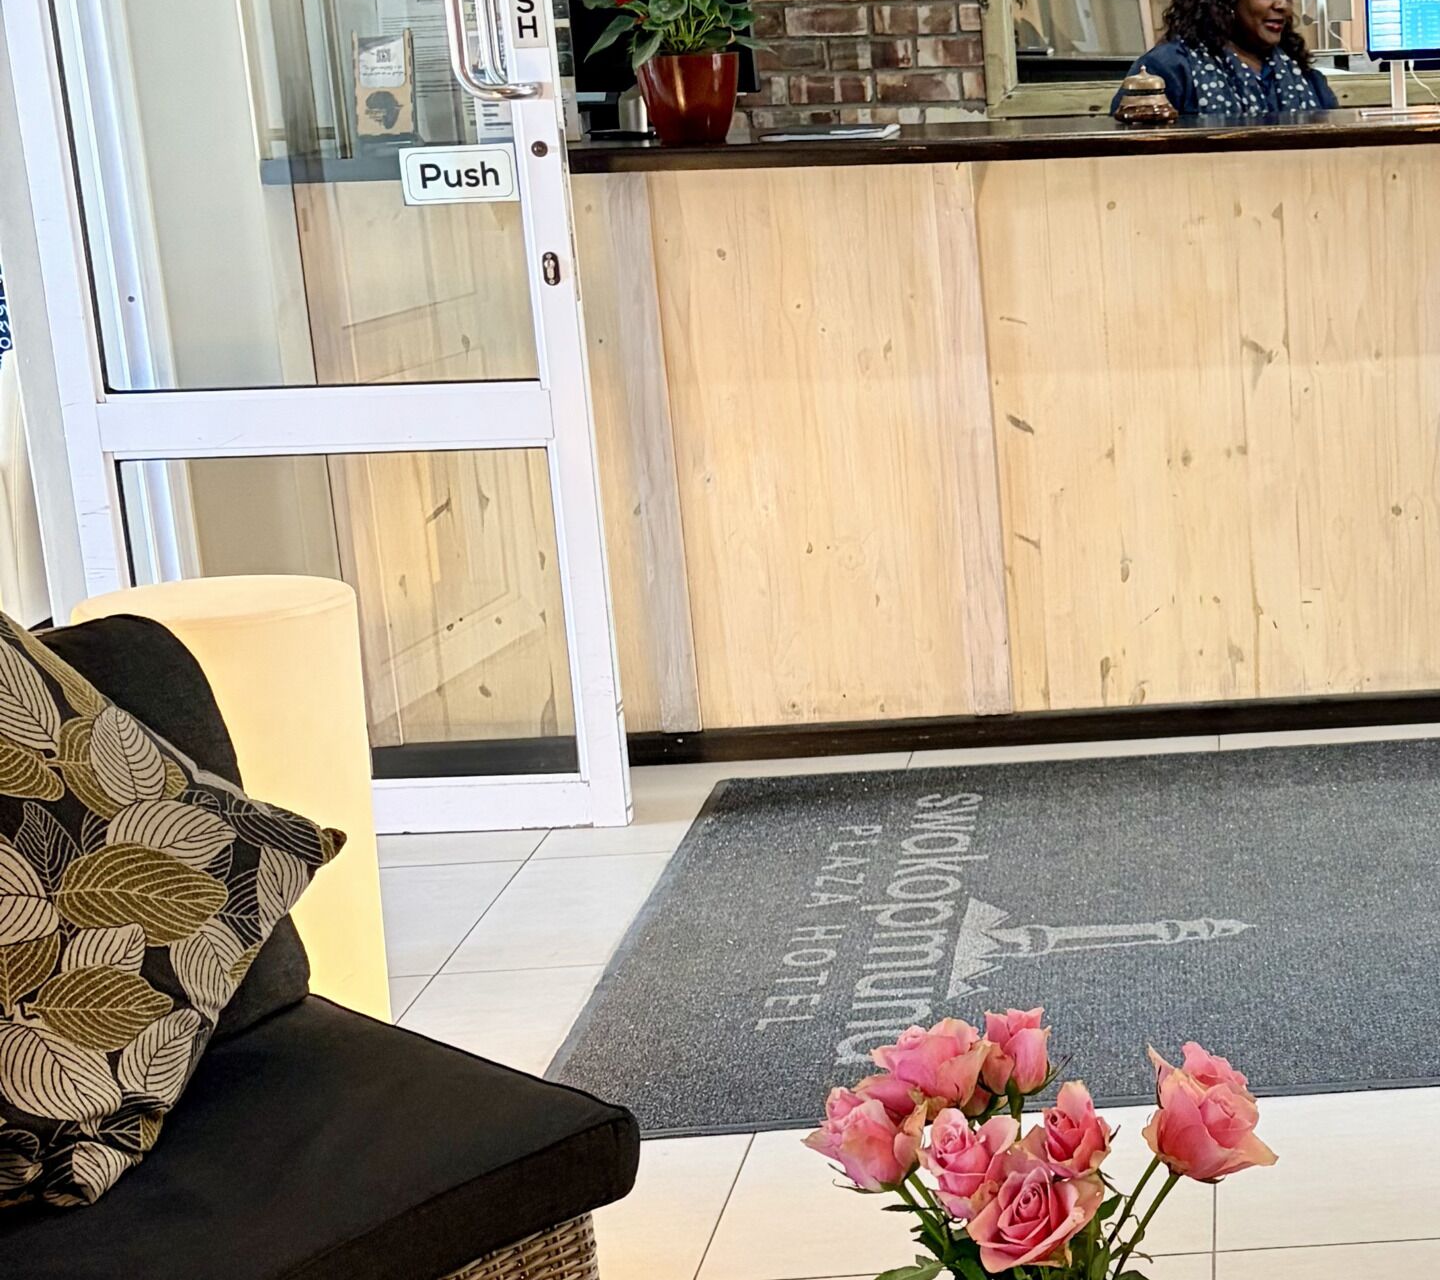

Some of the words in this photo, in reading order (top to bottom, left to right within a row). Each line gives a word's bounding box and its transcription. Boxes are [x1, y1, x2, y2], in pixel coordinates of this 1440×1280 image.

[420, 161, 500, 190] Push
[806, 824, 883, 908] PLAZA
[755, 924, 847, 1032] HOTEL
